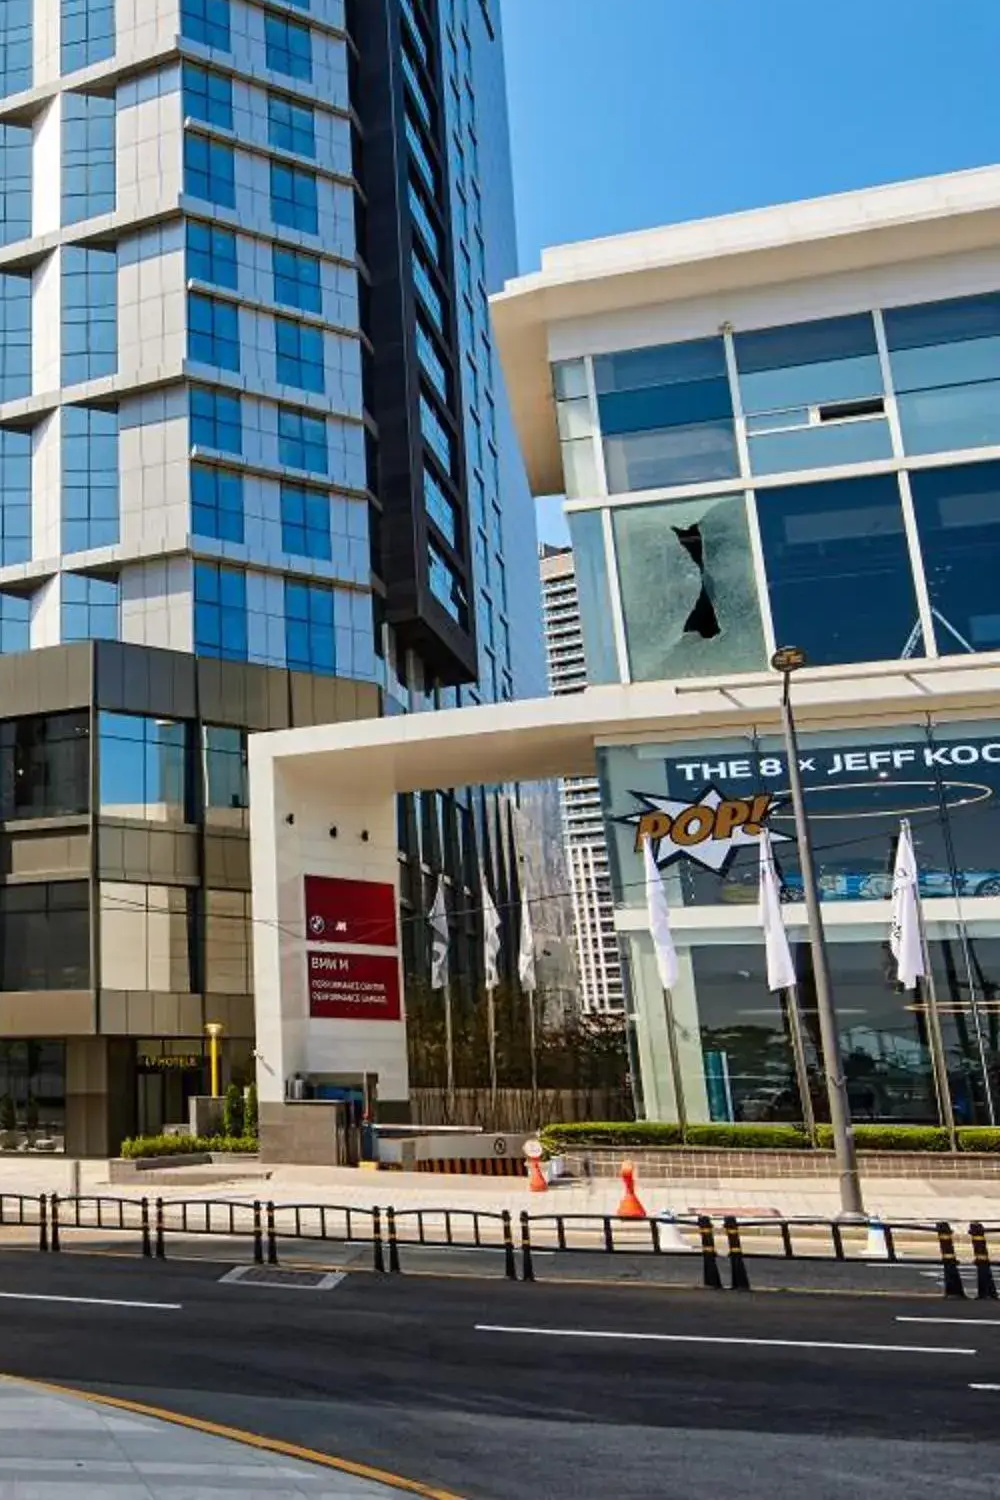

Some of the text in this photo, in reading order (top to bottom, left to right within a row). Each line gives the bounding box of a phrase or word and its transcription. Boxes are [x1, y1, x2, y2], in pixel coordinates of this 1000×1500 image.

[676, 759, 751, 781] THE
[759, 757, 783, 775] 8
[827, 749, 915, 775] JEFF
[634, 793, 773, 852] POP!
